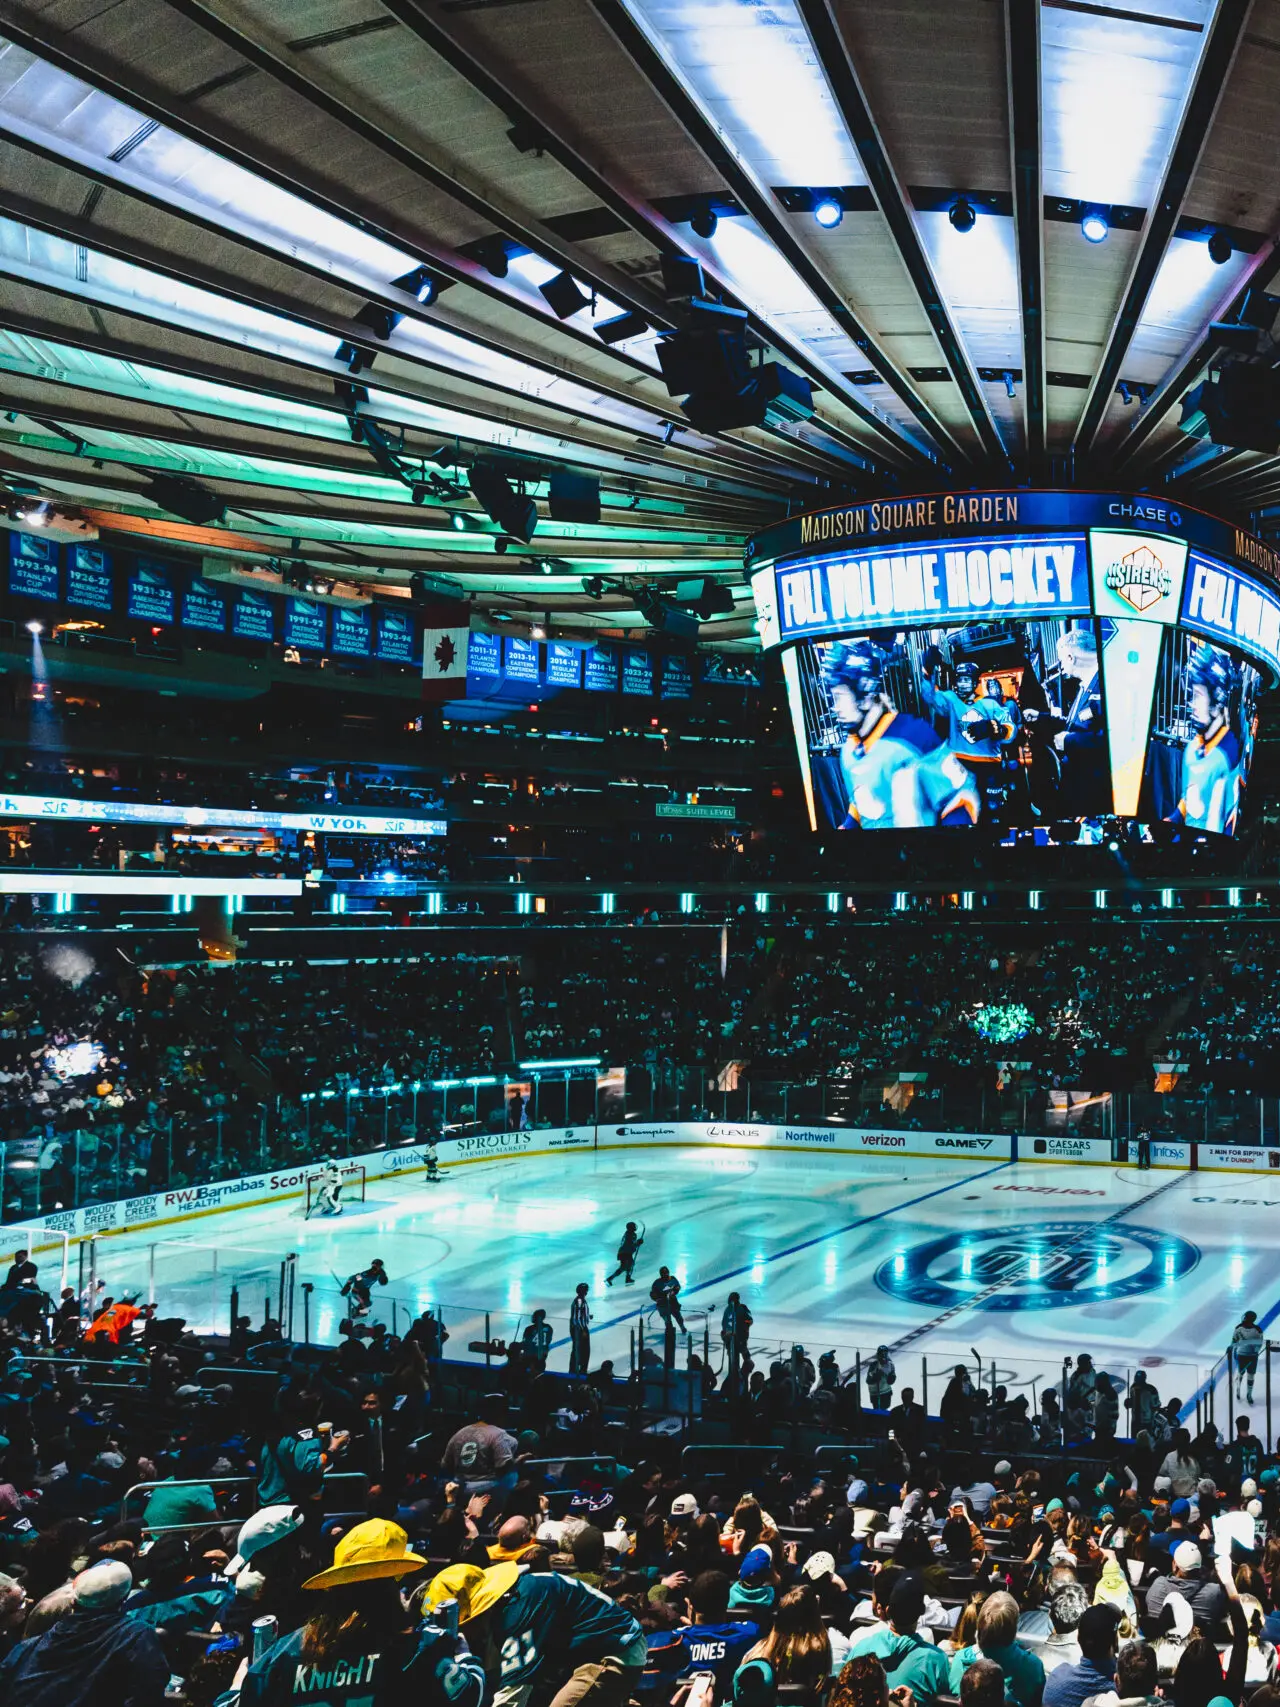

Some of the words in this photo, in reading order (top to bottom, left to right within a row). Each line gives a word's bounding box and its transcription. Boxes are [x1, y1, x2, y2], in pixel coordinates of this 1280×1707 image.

[801, 510, 865, 543] MADISON
[871, 500, 936, 532] SQUARE
[943, 495, 1018, 524] GARDEN
[1109, 504, 1166, 522] CHASE
[16, 570, 52, 582] STANLEY
[1116, 563, 1169, 593] SIRENS
[26, 578, 42, 587] CUP
[70, 582, 108, 595] AMERICAN
[781, 567, 828, 628] FULL
[827, 553, 941, 620] VOLUME
[944, 545, 1076, 608] HOCKEY
[10, 584, 57, 600] CHAMPIONS
[74, 590, 105, 600] DIVISION
[1189, 563, 1235, 631] FULL
[68, 596, 112, 610] CHAMPIONS
[136, 602, 166, 613] DIVISION
[128, 608, 172, 622] CHAMPIONS
[289, 614, 324, 628] 1991-92
[182, 618, 224, 630] CHAMPIONS
[336, 622, 368, 636] 1991-92
[333, 644, 368, 655] CHAMPIONS
[470, 646, 497, 656] 2011-12
[472, 660, 494, 668] DIVISION
[510, 660, 534, 668] EASTERN
[550, 657, 578, 667] 2014-15
[588, 663, 616, 672] 2014-15
[467, 666, 499, 674] CHAMPIONS
[507, 671, 536, 679] CHAMPIONS
[552, 665, 576, 673] REGULAR
[548, 676, 578, 684] CHAMPIONS
[721, 1127, 760, 1137] LEXUS
[785, 1131, 835, 1143] Northwell
[457, 1132, 531, 1152] SPROUTS
[861, 1134, 906, 1147] verizon
[1049, 1140, 1090, 1150] CAESARS
[460, 1150, 494, 1158] FARMERS
[1153, 1145, 1184, 1160] Infosys
[993, 1184, 1106, 1196] verizon
[125, 1196, 158, 1209] WOODY
[178, 1196, 222, 1212] HEALTH
[84, 1203, 118, 1217] WOODY
[124, 1204, 156, 1218] CREEK
[44, 1212, 76, 1226] WOODY
[84, 1213, 116, 1226] CREEK
